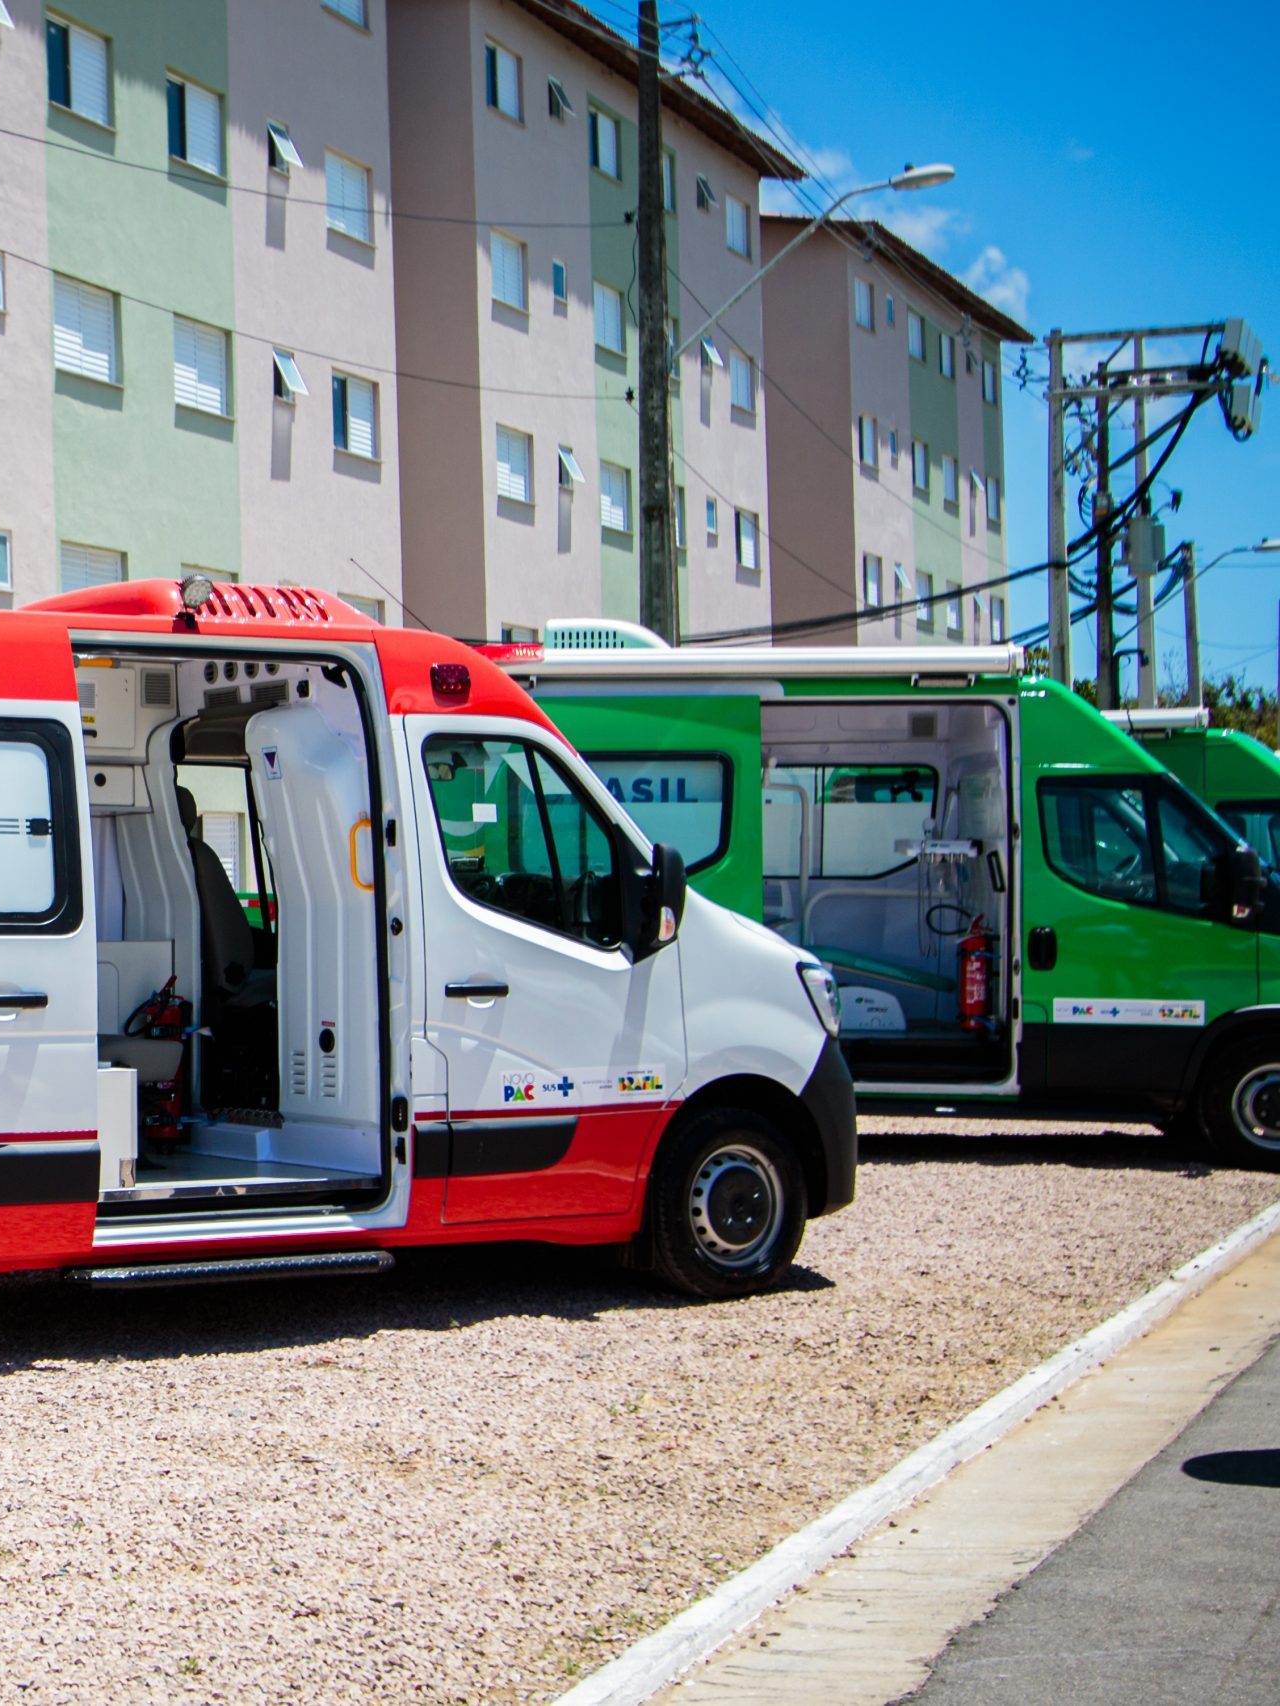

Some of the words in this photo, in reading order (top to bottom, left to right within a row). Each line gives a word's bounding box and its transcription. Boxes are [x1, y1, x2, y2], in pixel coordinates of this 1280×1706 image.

[603, 777, 699, 803] ASIL
[503, 1073, 535, 1085] NOVO
[618, 1075, 663, 1092] BRASIL
[504, 1085, 535, 1102] PAC
